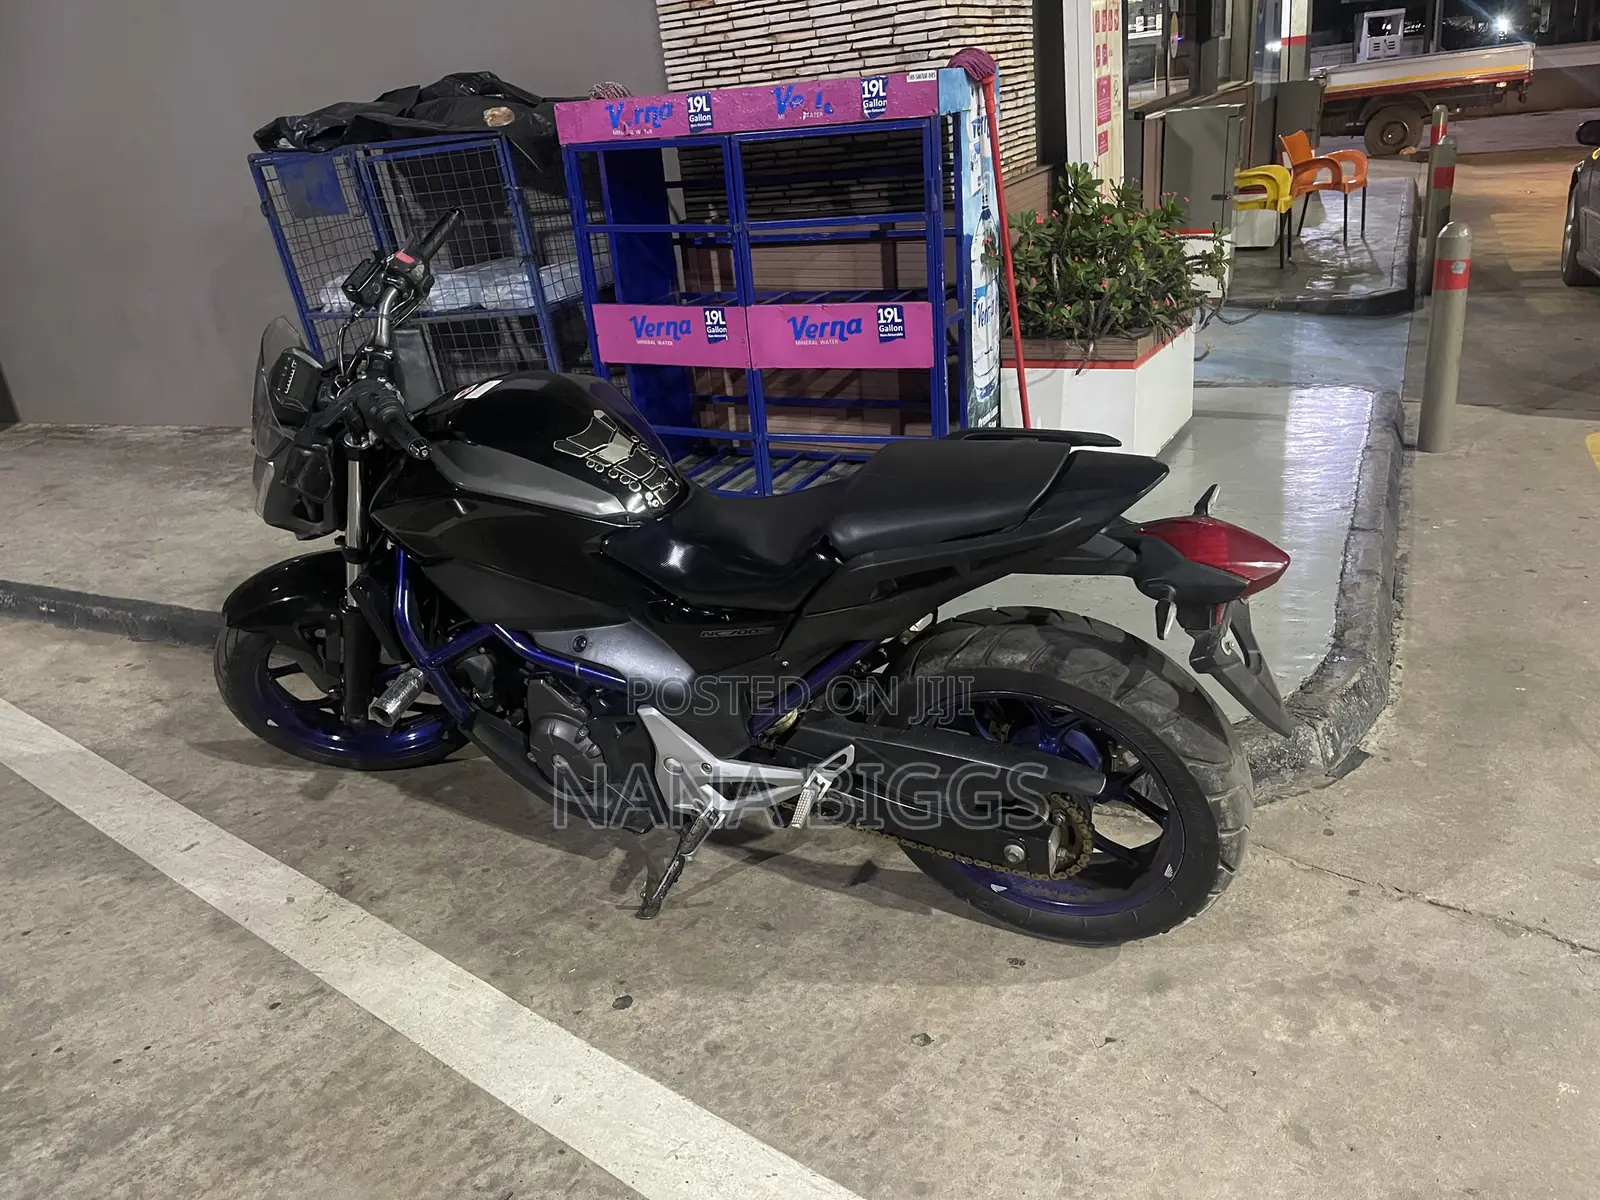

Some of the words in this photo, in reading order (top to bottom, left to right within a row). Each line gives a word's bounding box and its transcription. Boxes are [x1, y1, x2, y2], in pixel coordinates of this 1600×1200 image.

[862, 79, 887, 98] 19L
[687, 95, 710, 113] 19L
[863, 98, 888, 108] Gallon
[688, 113, 712, 123] Gallon
[705, 310, 726, 325] 19L
[878, 307, 902, 323] 19L
[629, 315, 692, 341] Verna
[706, 325, 728, 334] Gallon
[787, 315, 863, 342] Verna
[879, 323, 903, 333] Gallon
